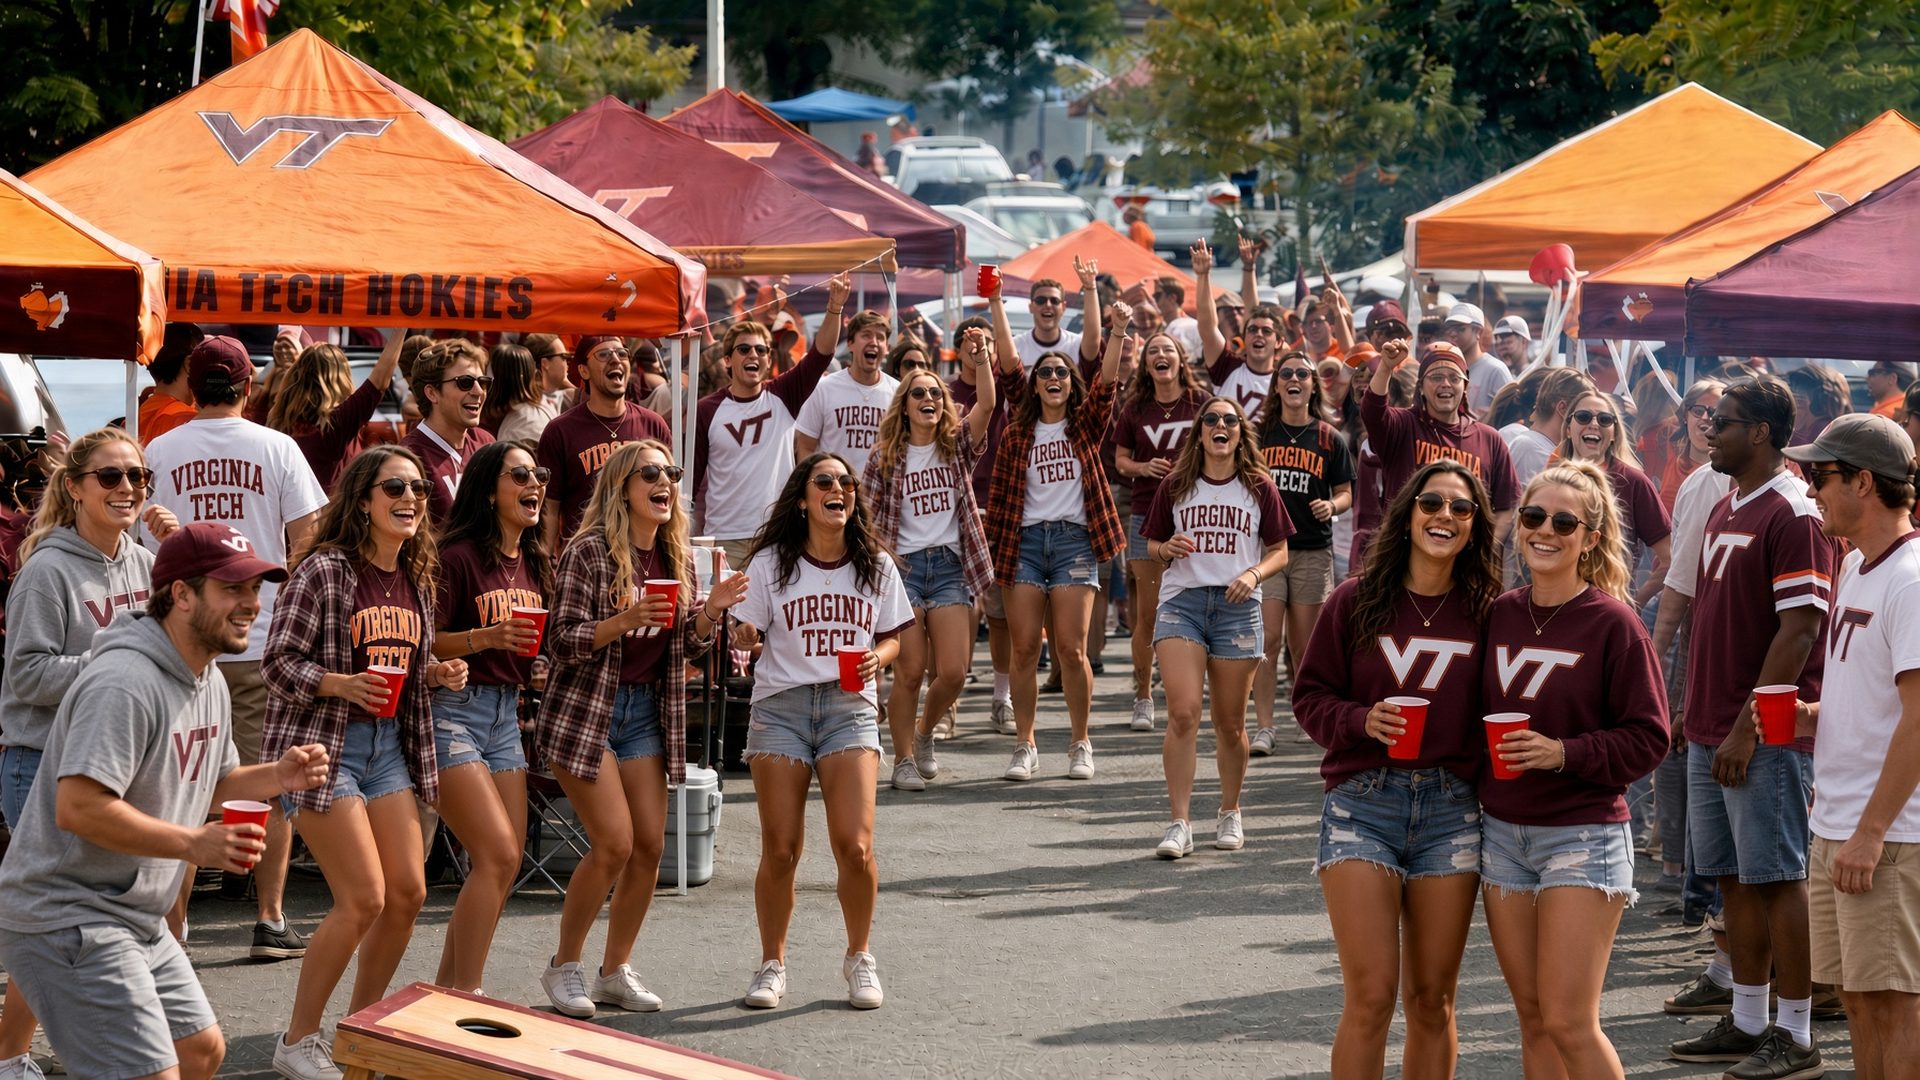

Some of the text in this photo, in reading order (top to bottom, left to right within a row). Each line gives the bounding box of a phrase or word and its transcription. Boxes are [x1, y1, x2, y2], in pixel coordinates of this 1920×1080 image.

[197, 111, 397, 169] VT
[239, 272, 345, 315] TECH
[366, 273, 533, 320] HOKIES
[723, 409, 773, 448] VT
[1143, 420, 1194, 450] VT
[171, 458, 265, 496] VIRGINIA
[1037, 460, 1076, 484] TECH
[1260, 446, 1324, 480] VIRGINIA
[1270, 469, 1311, 494] TECH
[190, 492, 244, 521] TECH
[910, 491, 951, 516] TECH
[1179, 504, 1252, 537] VIRGINIA
[1193, 531, 1237, 554] TECH
[1702, 532, 1757, 582] VT
[782, 593, 873, 634] VIRGINIA
[802, 629, 856, 656] TECH
[1829, 606, 1874, 662] VT
[367, 646, 412, 673] TECH
[1377, 634, 1477, 692] VT
[1495, 644, 1586, 701] VT
[172, 724, 220, 784] VT
